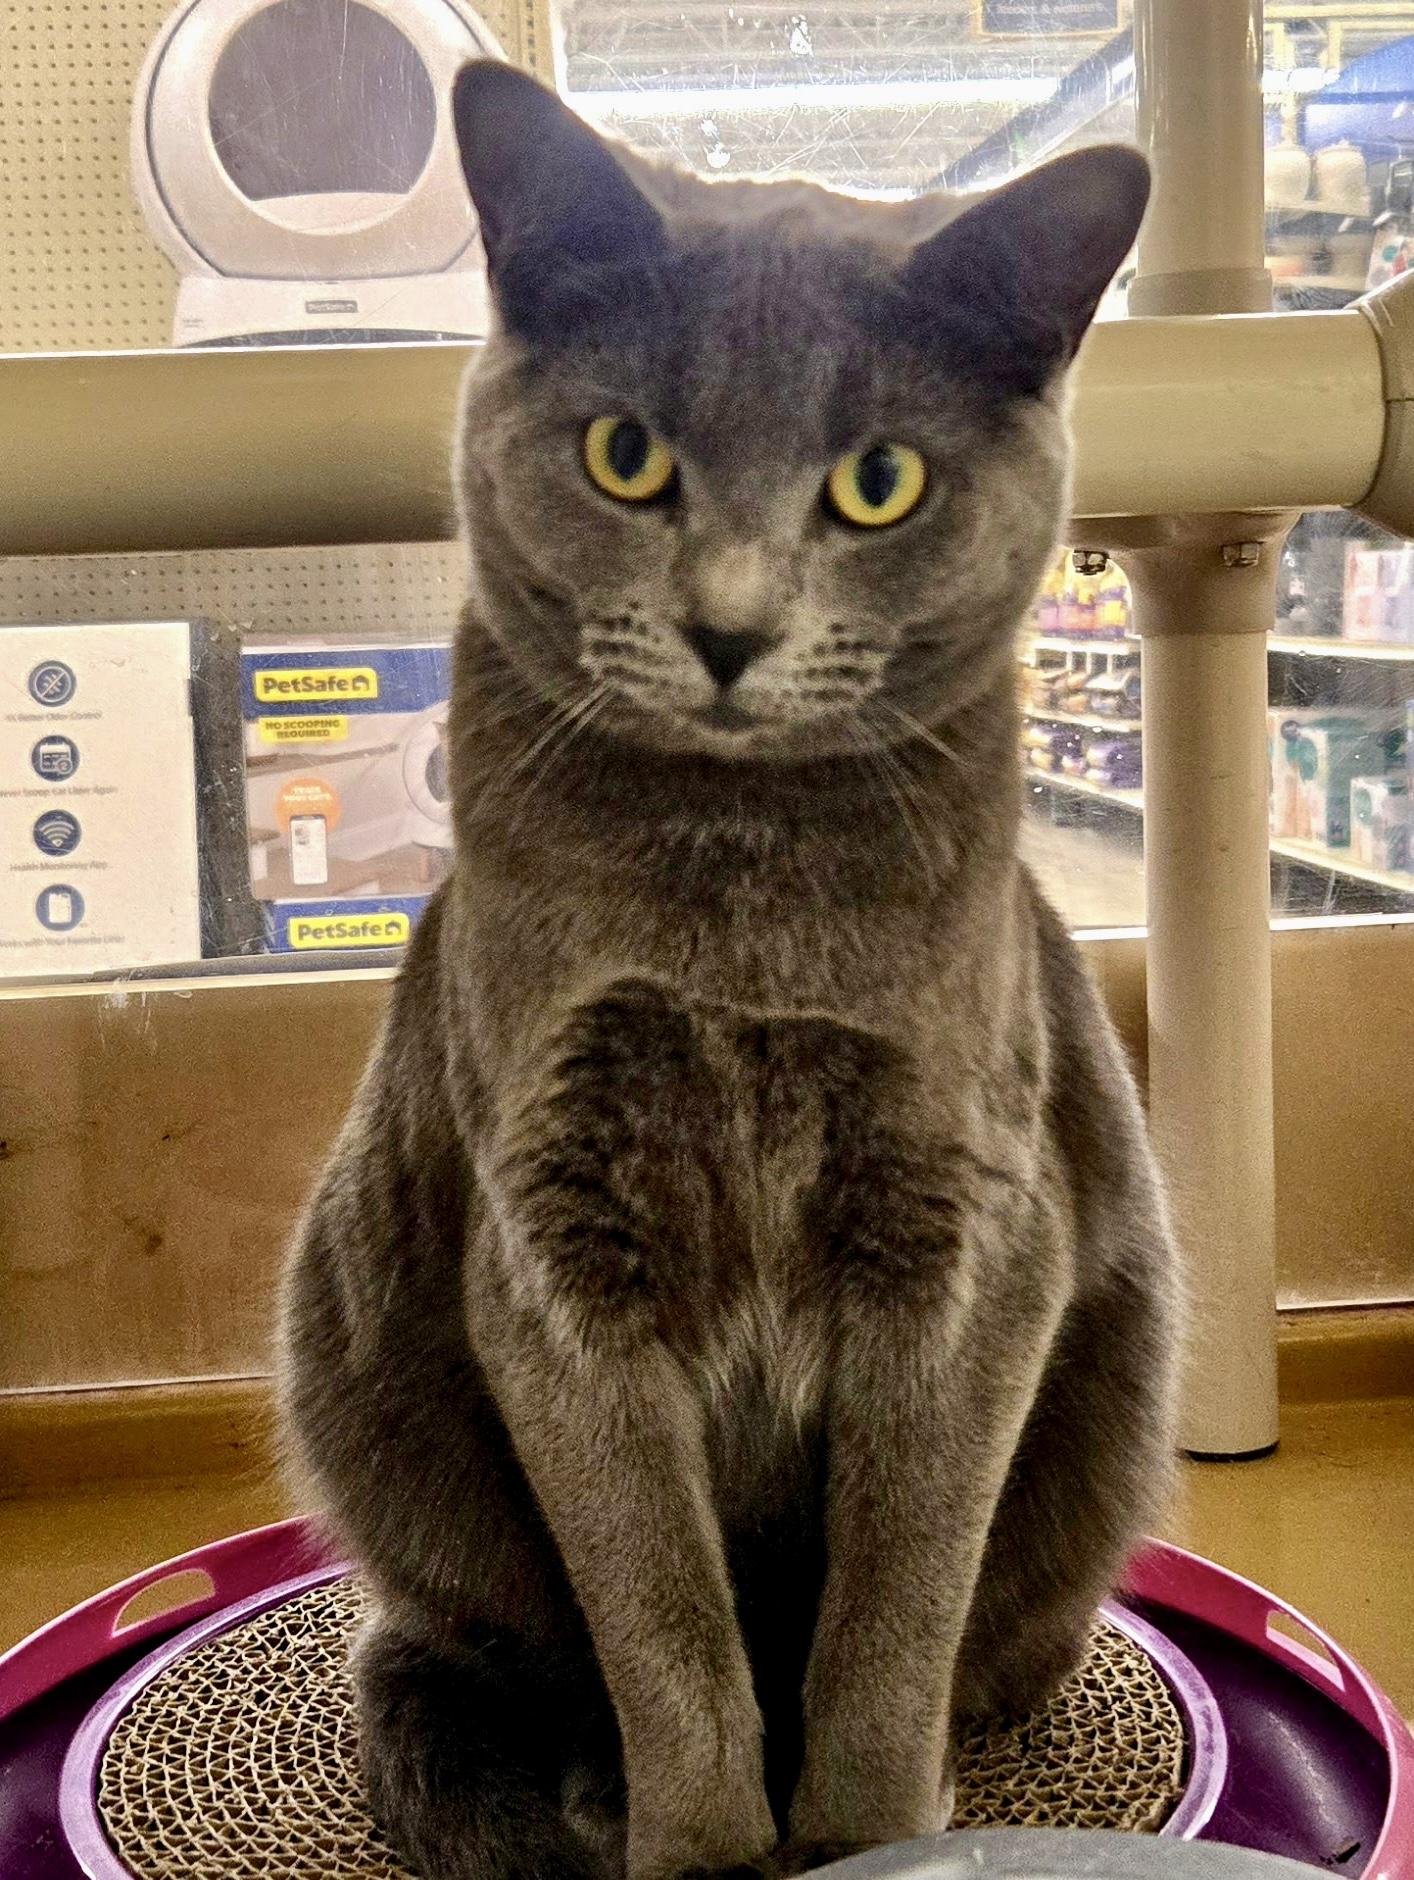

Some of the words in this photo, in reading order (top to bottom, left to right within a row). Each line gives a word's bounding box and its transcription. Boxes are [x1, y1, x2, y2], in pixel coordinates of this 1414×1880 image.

[262, 676, 348, 694] PetSafe
[265, 721, 282, 730] NO
[283, 719, 341, 730] SCOOPING
[276, 729, 330, 739] REQUIRED
[297, 921, 382, 941] PetSafe
